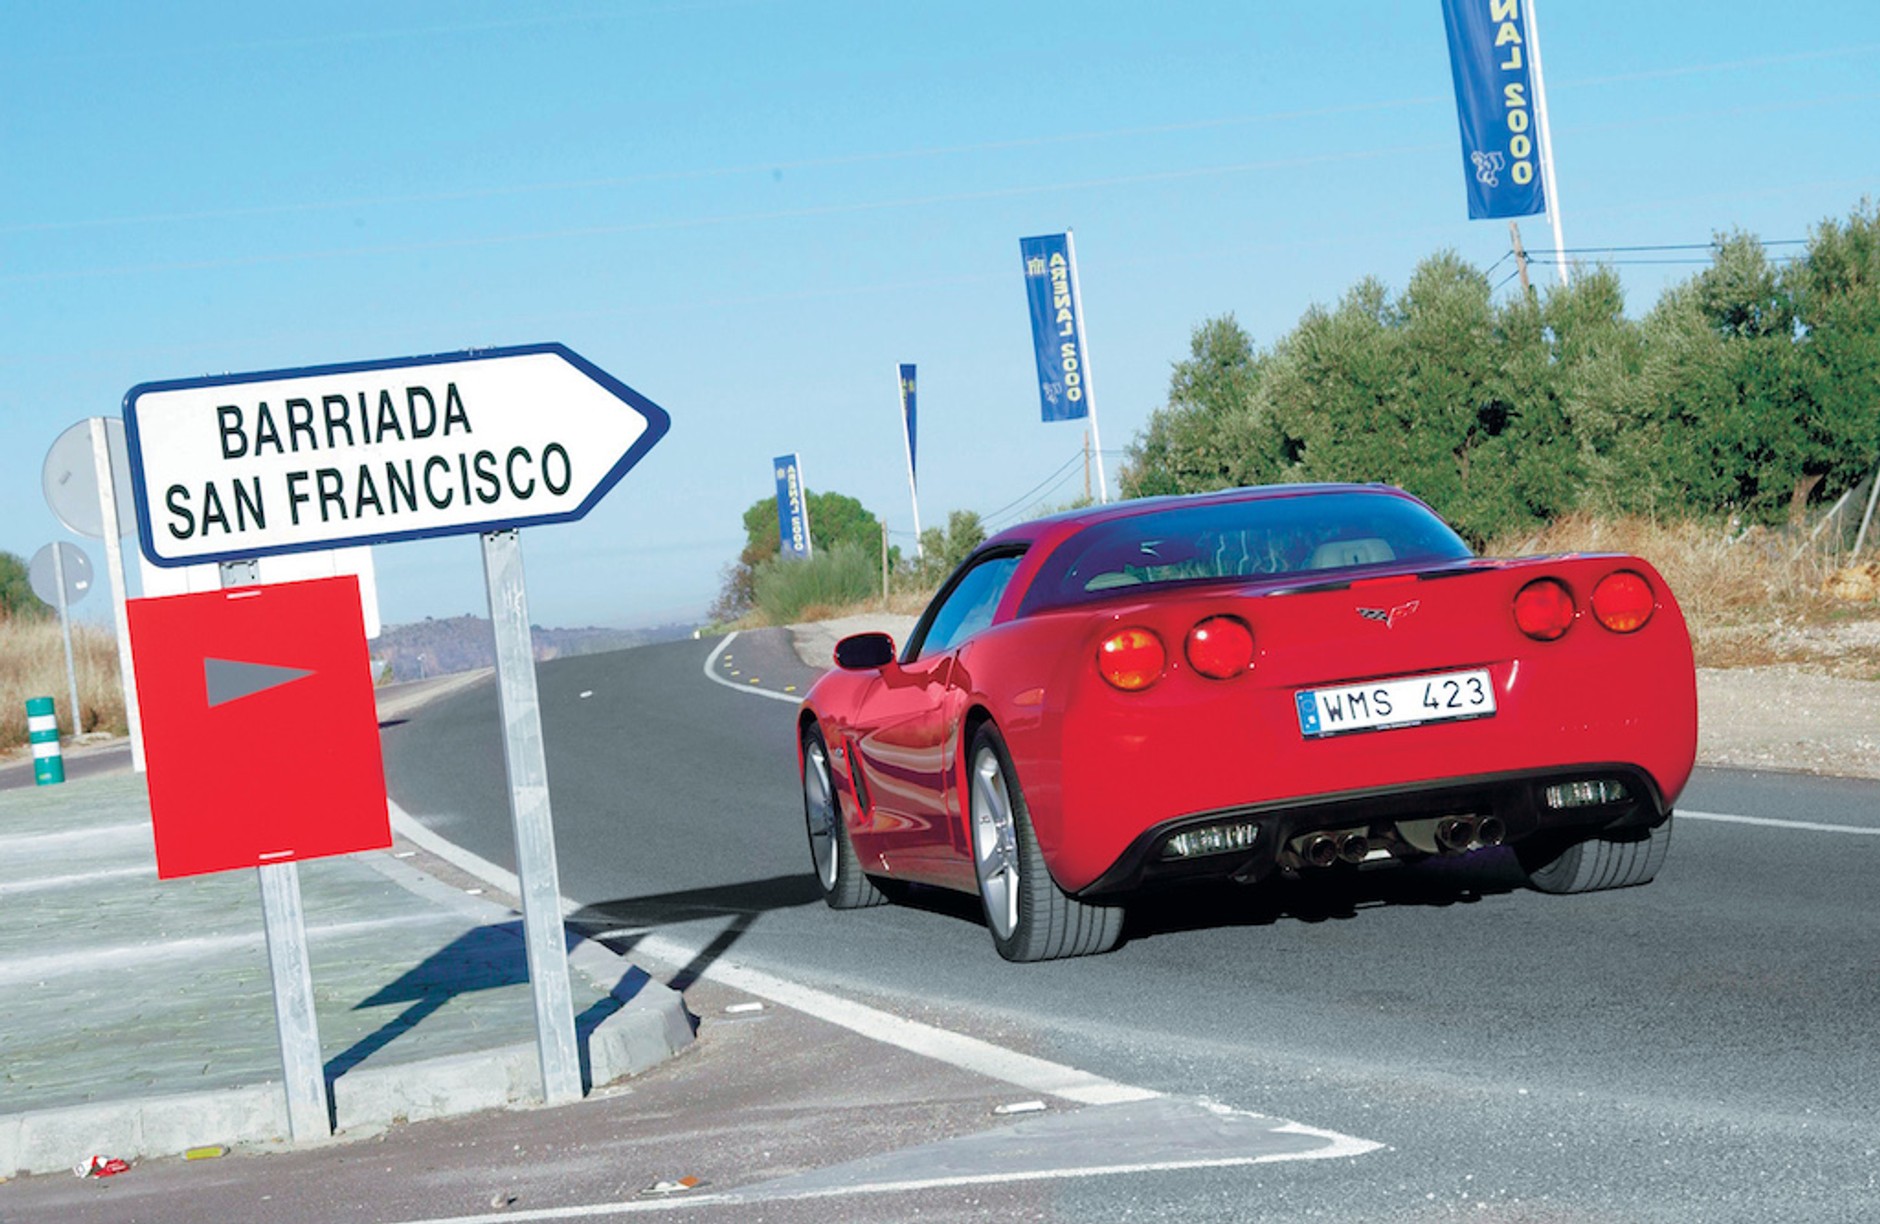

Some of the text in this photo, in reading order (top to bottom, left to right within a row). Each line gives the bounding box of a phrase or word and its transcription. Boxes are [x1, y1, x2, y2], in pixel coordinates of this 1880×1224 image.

[216, 381, 473, 460] BARRIADA
[164, 441, 574, 540] SAN FRANCISCO
[1322, 677, 1486, 723] WMS 423
